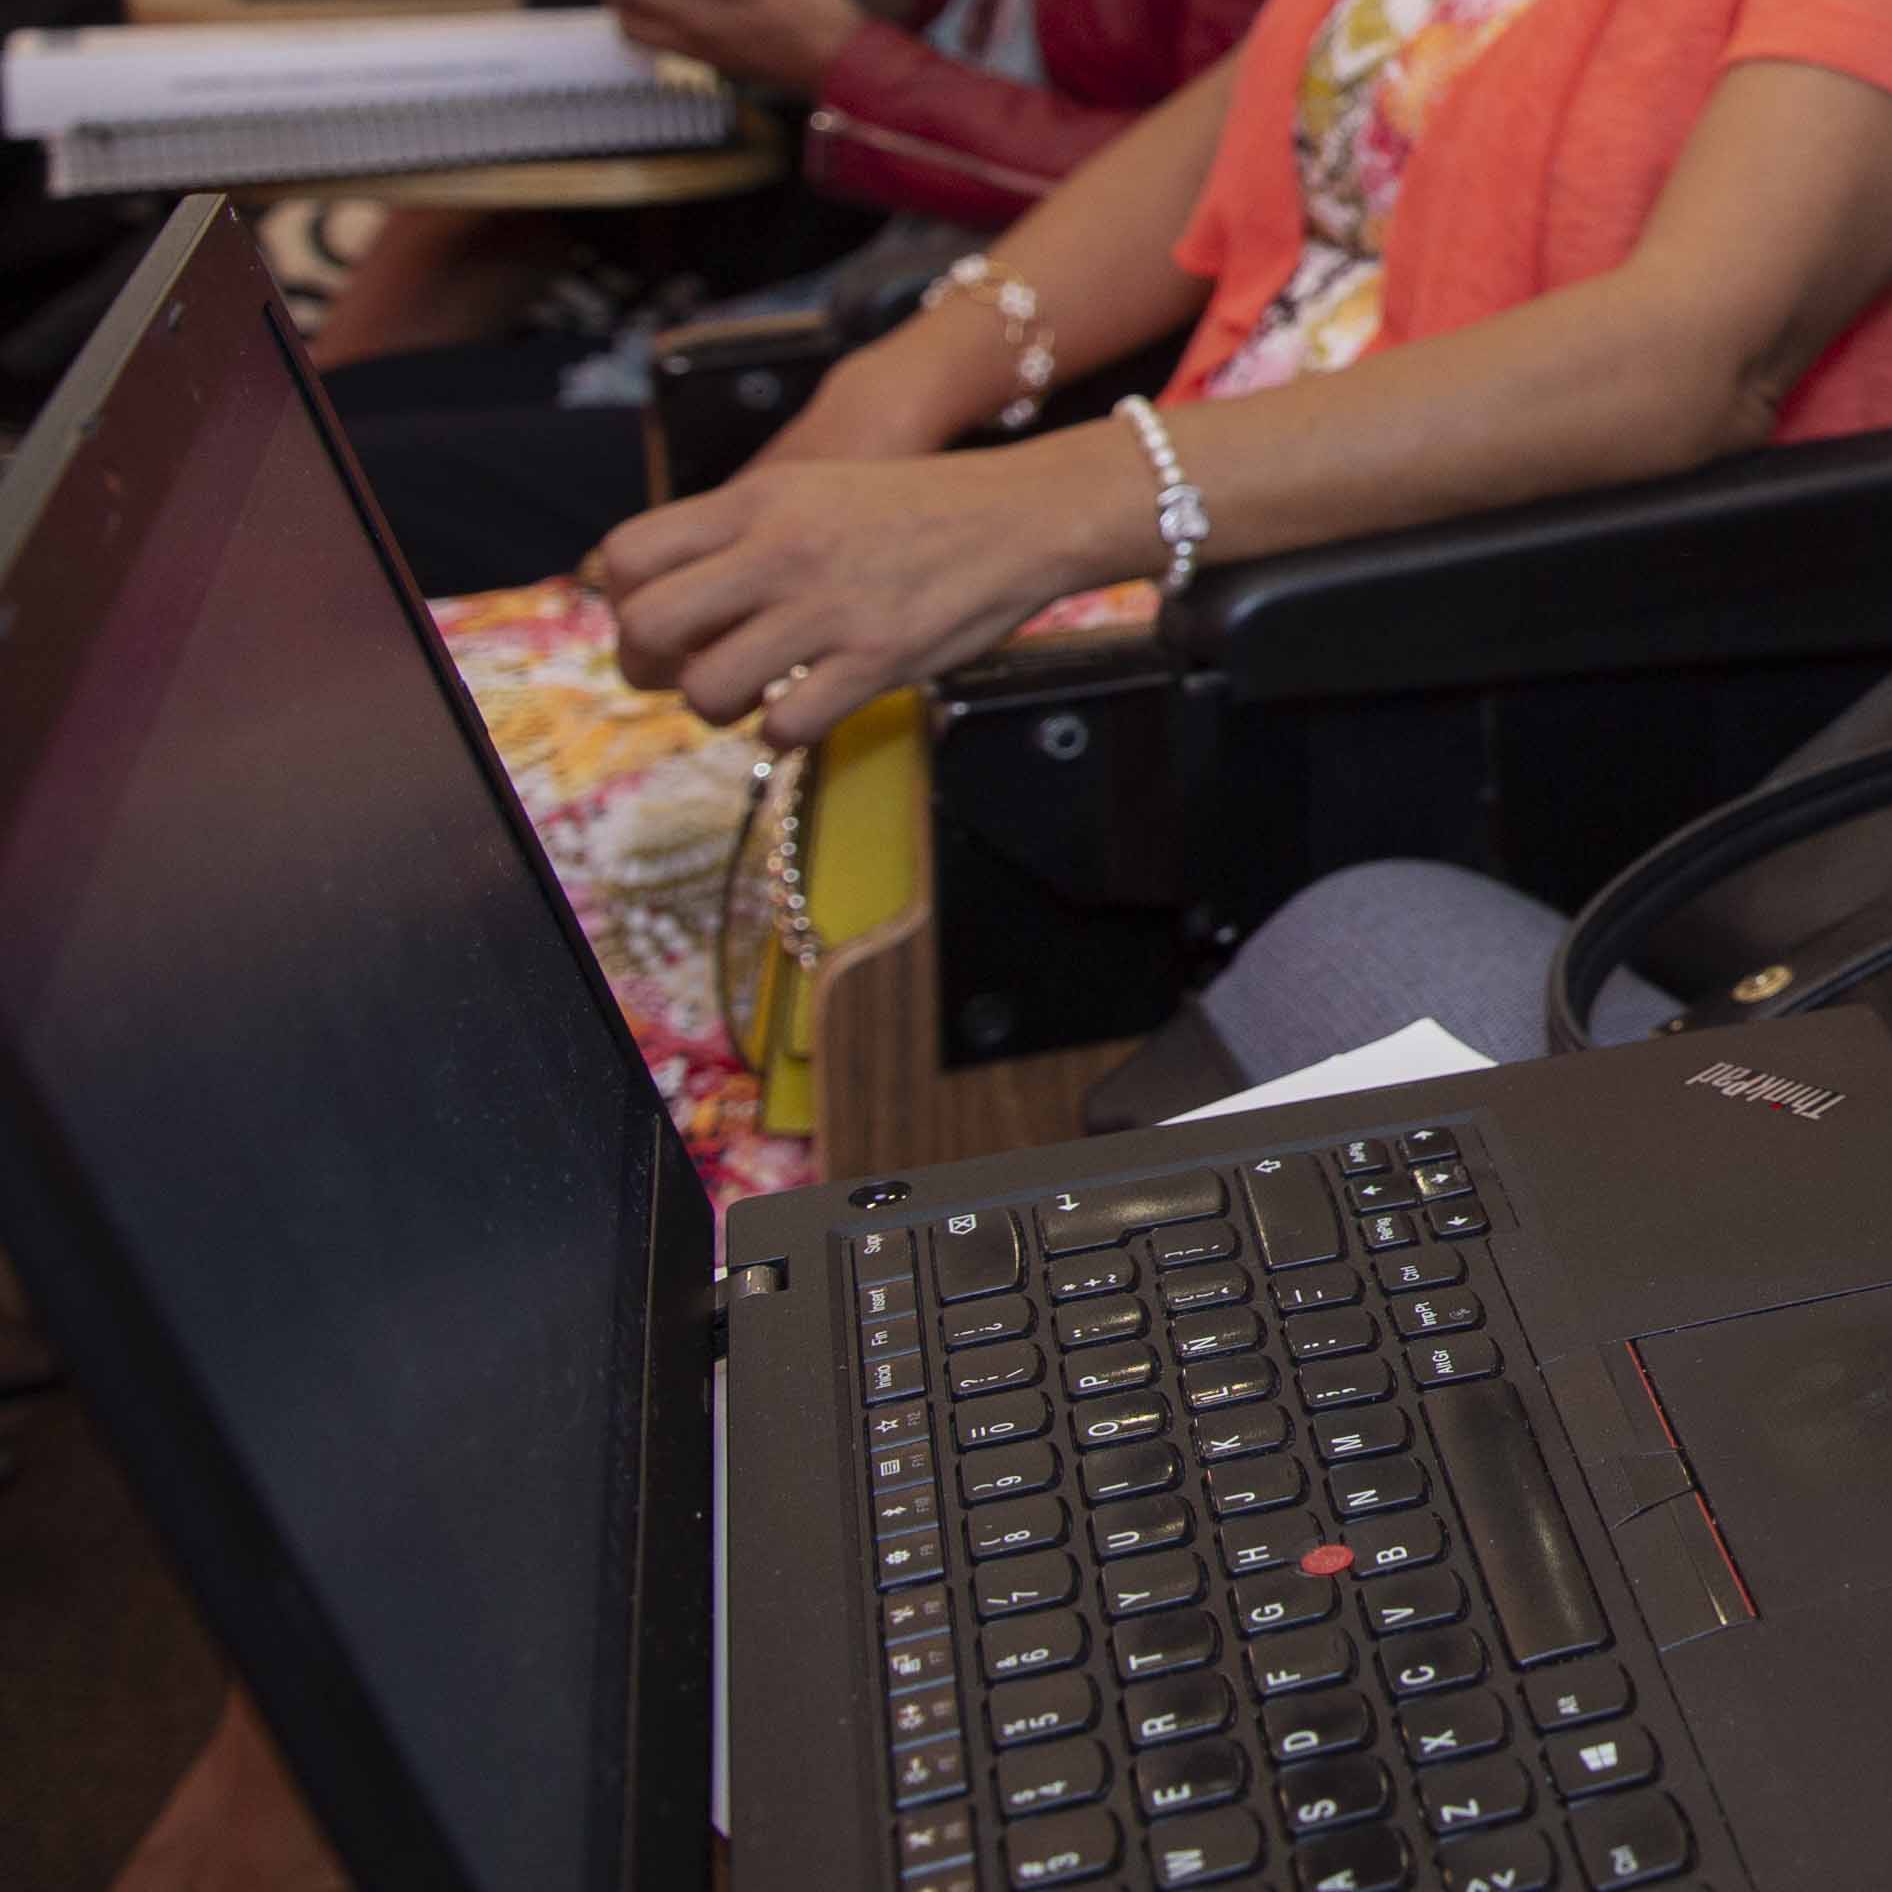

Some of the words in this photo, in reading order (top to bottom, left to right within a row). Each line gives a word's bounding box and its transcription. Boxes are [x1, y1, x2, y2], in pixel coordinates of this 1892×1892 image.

[1685, 1062, 1846, 1120] ThinkPad
[864, 1234, 884, 1255] Supr
[1400, 1265, 1420, 1282] Ctrl
[870, 1288, 885, 1313] Insert
[871, 1330, 888, 1346] Fin
[1182, 1335, 1218, 1351] Ñ
[874, 1364, 891, 1389] Inicio
[1079, 1376, 1109, 1387] P
[1199, 1386, 1228, 1401] L
[990, 1422, 1015, 1433] 0
[1088, 1422, 1118, 1436] O
[1210, 1435, 1241, 1451] K
[1331, 1434, 1363, 1452] M
[996, 1475, 1022, 1487] 9
[1224, 1492, 1255, 1502] J
[1347, 1489, 1379, 1507] N
[1004, 1530, 1031, 1542] 8
[1107, 1531, 1140, 1548] U
[1237, 1546, 1270, 1564] H
[1377, 1546, 1408, 1564] B
[1012, 1592, 1039, 1602] 7
[1117, 1592, 1150, 1607] Y
[1251, 1602, 1284, 1622] G
[1382, 1608, 1414, 1624] V
[1020, 1648, 1048, 1663] 6
[1128, 1653, 1162, 1670] T
[1266, 1670, 1301, 1685] F
[1400, 1665, 1435, 1684] C
[1029, 1712, 1058, 1729] 5
[1141, 1713, 1177, 1736] R
[1283, 1730, 1318, 1751] D
[1420, 1729, 1457, 1753] X
[1153, 1783, 1190, 1806] E
[1298, 1799, 1337, 1822] S
[1440, 1798, 1479, 1823] Z
[1164, 1849, 1204, 1880] W
[1317, 1869, 1356, 1891] A
